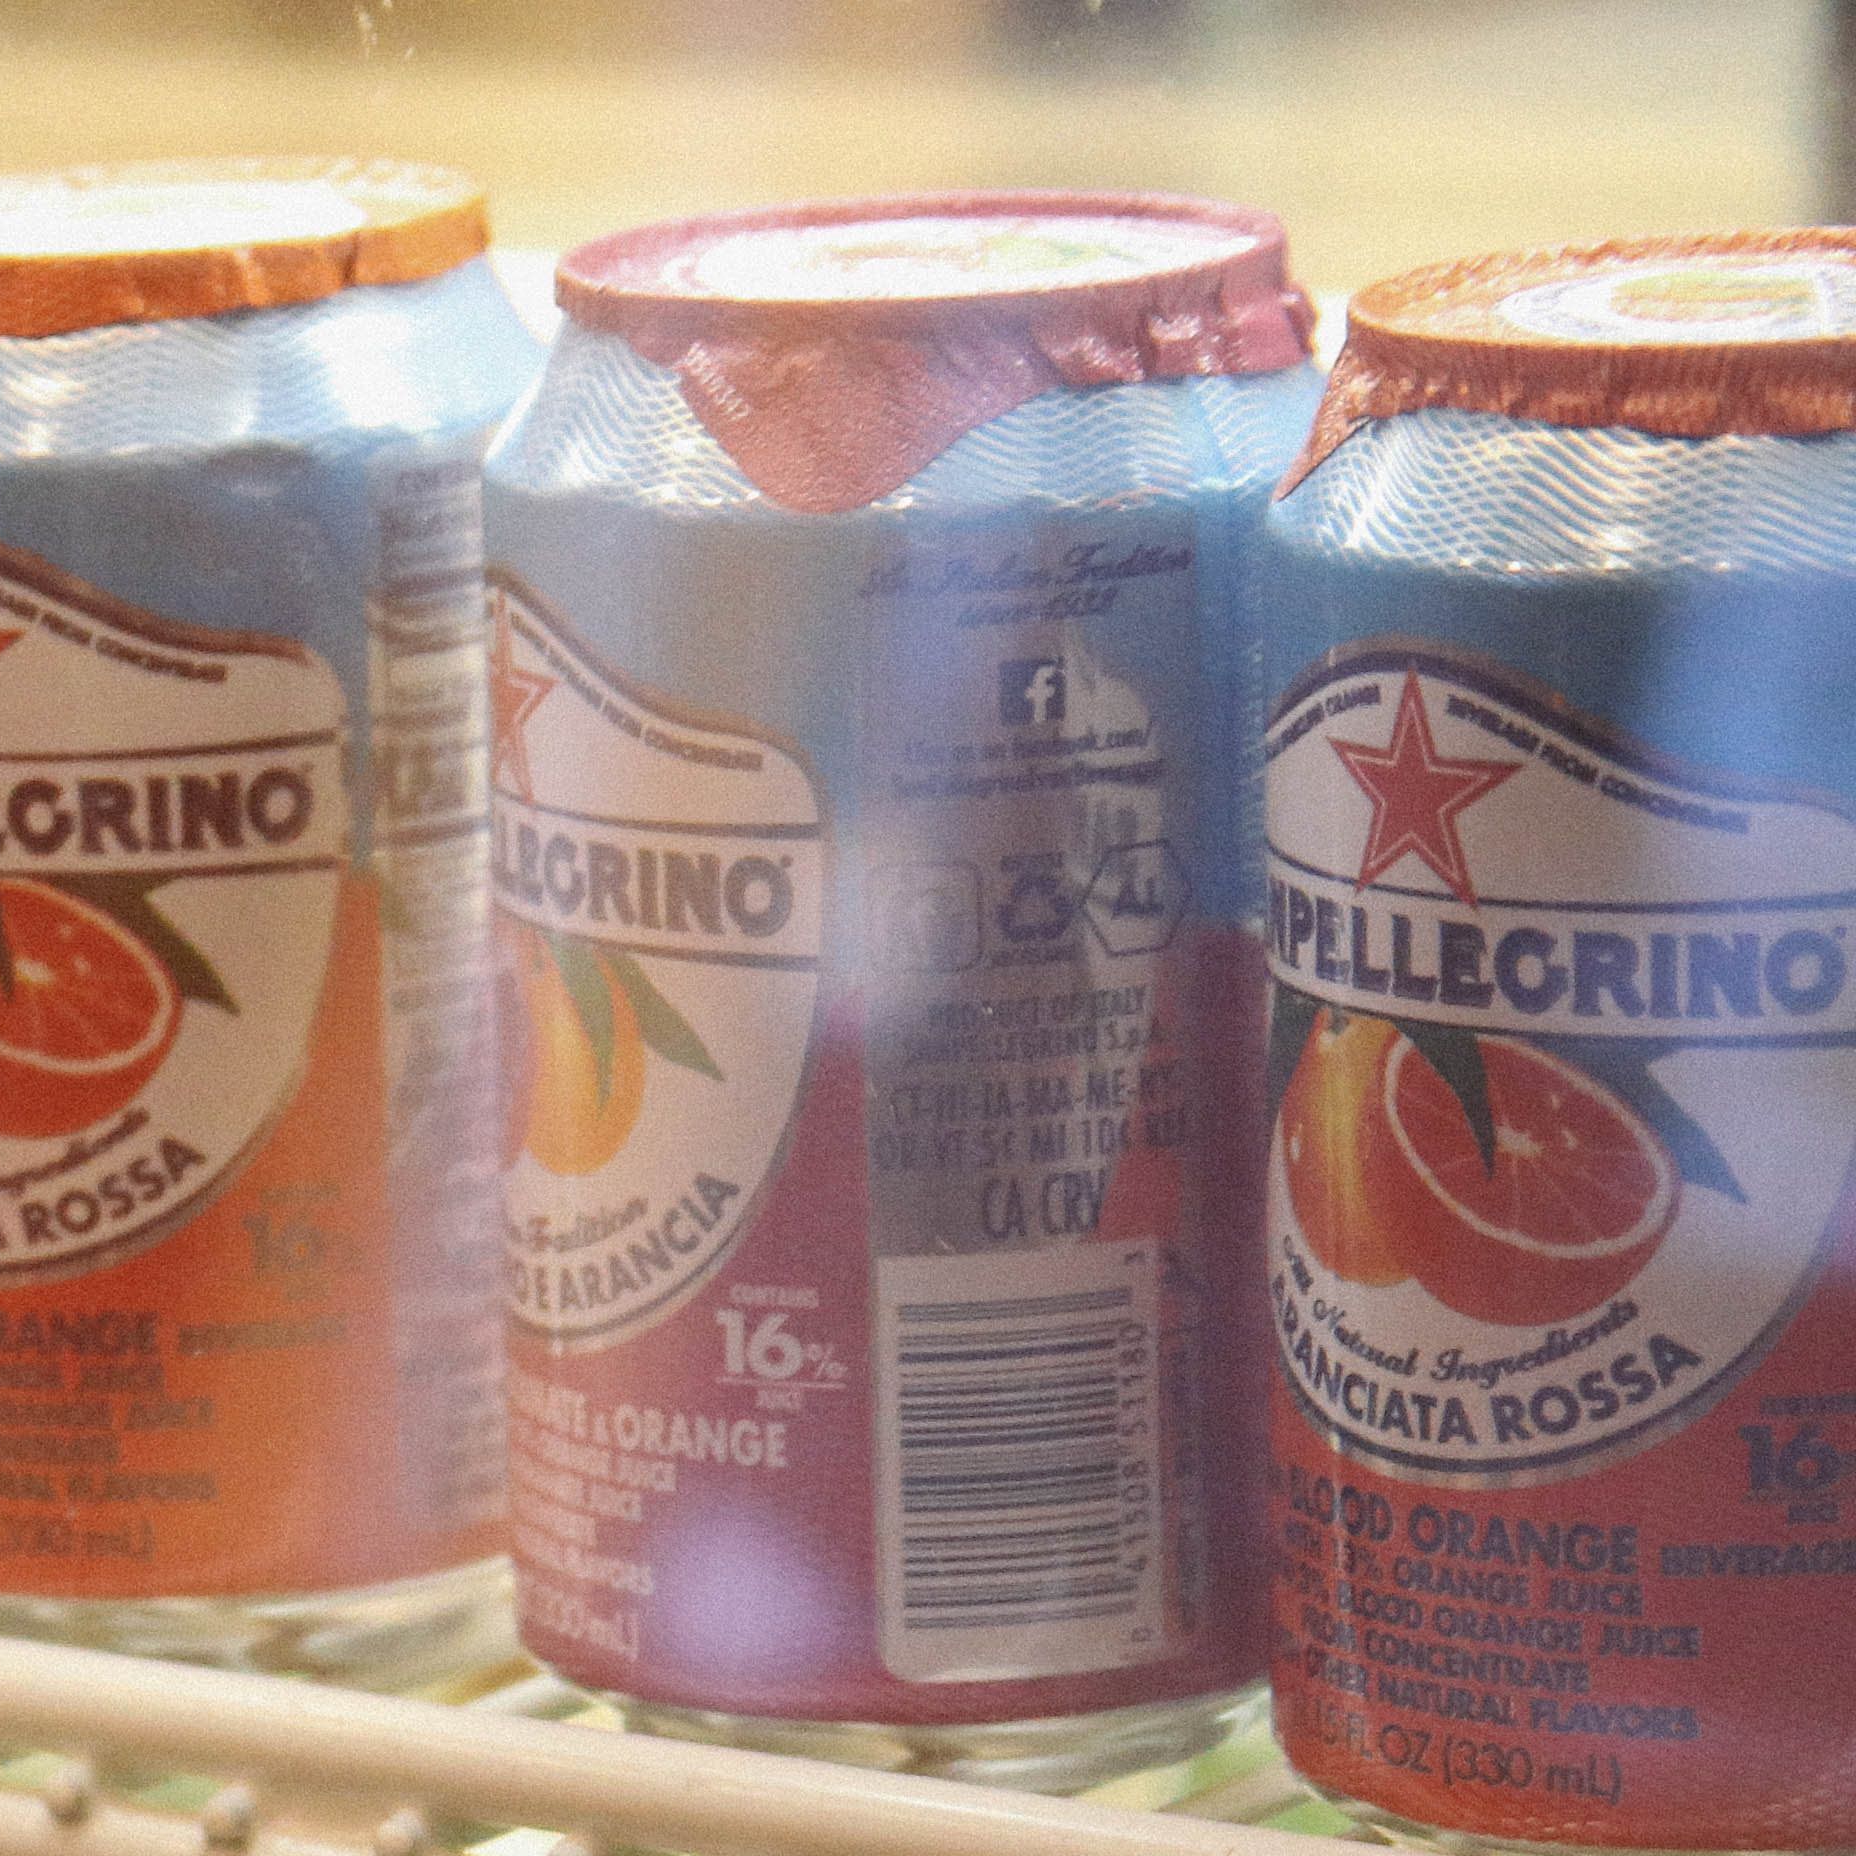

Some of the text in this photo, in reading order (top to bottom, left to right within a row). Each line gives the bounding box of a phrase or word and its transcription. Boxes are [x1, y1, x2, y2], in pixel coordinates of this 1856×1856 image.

[24, 1135, 207, 1253] ROSSA
[559, 1171, 741, 1313] ARANCIA
[714, 1307, 849, 1382] 16%
[1490, 1331, 1705, 1445] ROSSA
[613, 1402, 788, 1469] ORANGE
[1738, 1422, 1856, 1502] 16
[1408, 1502, 1640, 1577] ORANGE
[1392, 1557, 1530, 1608] ORANGE
[1548, 1578, 1644, 1617] JUICE
[1363, 1630, 1591, 1693] CONCENTRATE
[1431, 1606, 1583, 1653] ORANGE
[1597, 1625, 1702, 1658] JUICE
[1378, 1677, 1517, 1729] NATURAL
[1527, 1703, 1701, 1742] FLAVORS
[1442, 1735, 1535, 1788] (330
[1544, 1754, 1625, 1808] mL)
